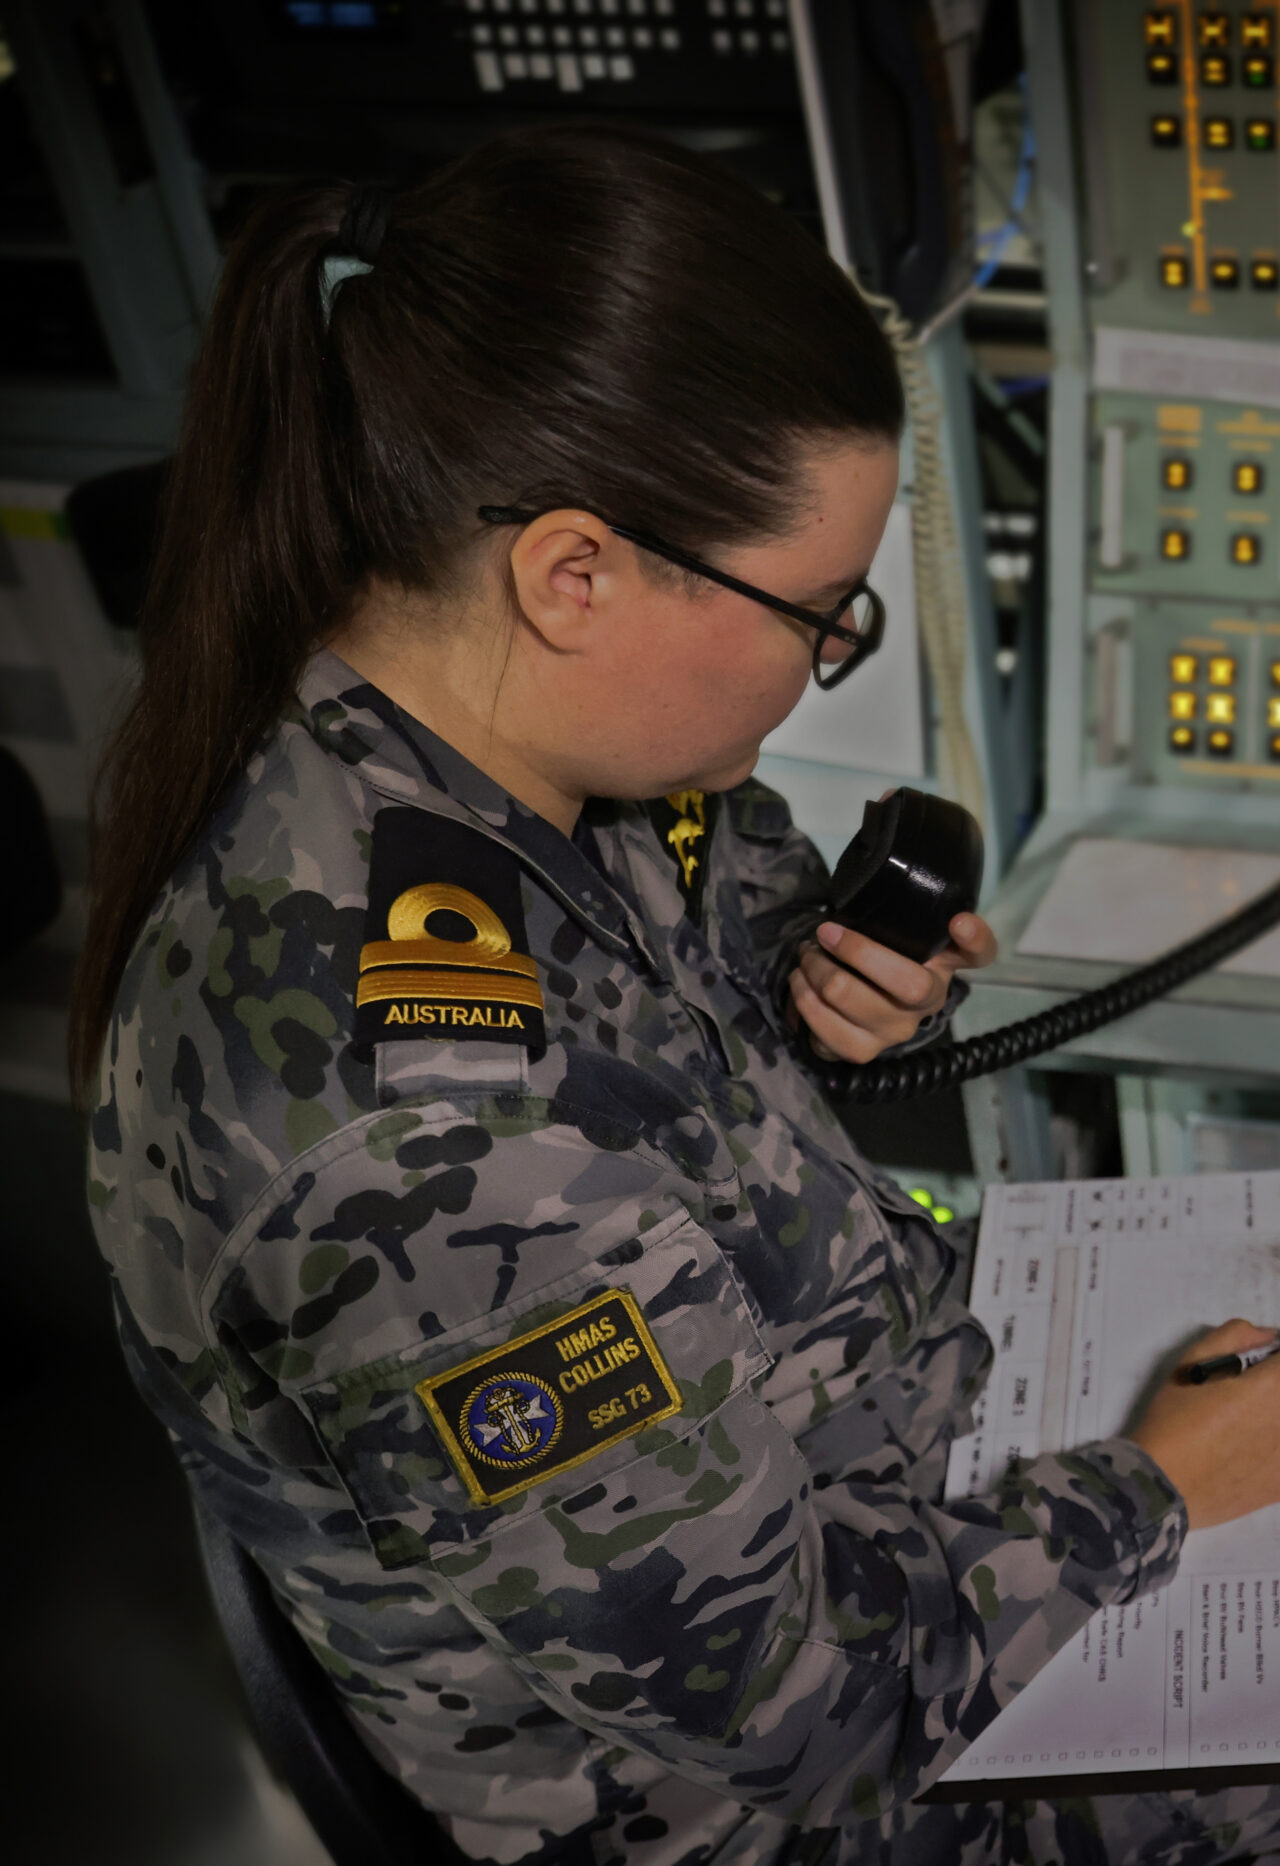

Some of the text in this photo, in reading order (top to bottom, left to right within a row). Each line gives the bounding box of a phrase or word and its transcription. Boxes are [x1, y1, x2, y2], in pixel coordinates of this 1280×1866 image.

[384, 1003, 525, 1029] AUSTRALIA
[554, 1316, 618, 1362] HMAS
[558, 1337, 641, 1394] COLLINS
[588, 1383, 653, 1430] SSG 73
[1013, 1378, 1028, 1406] ZONE
[1172, 1630, 1184, 1709] INCIDENT SCRIPT
